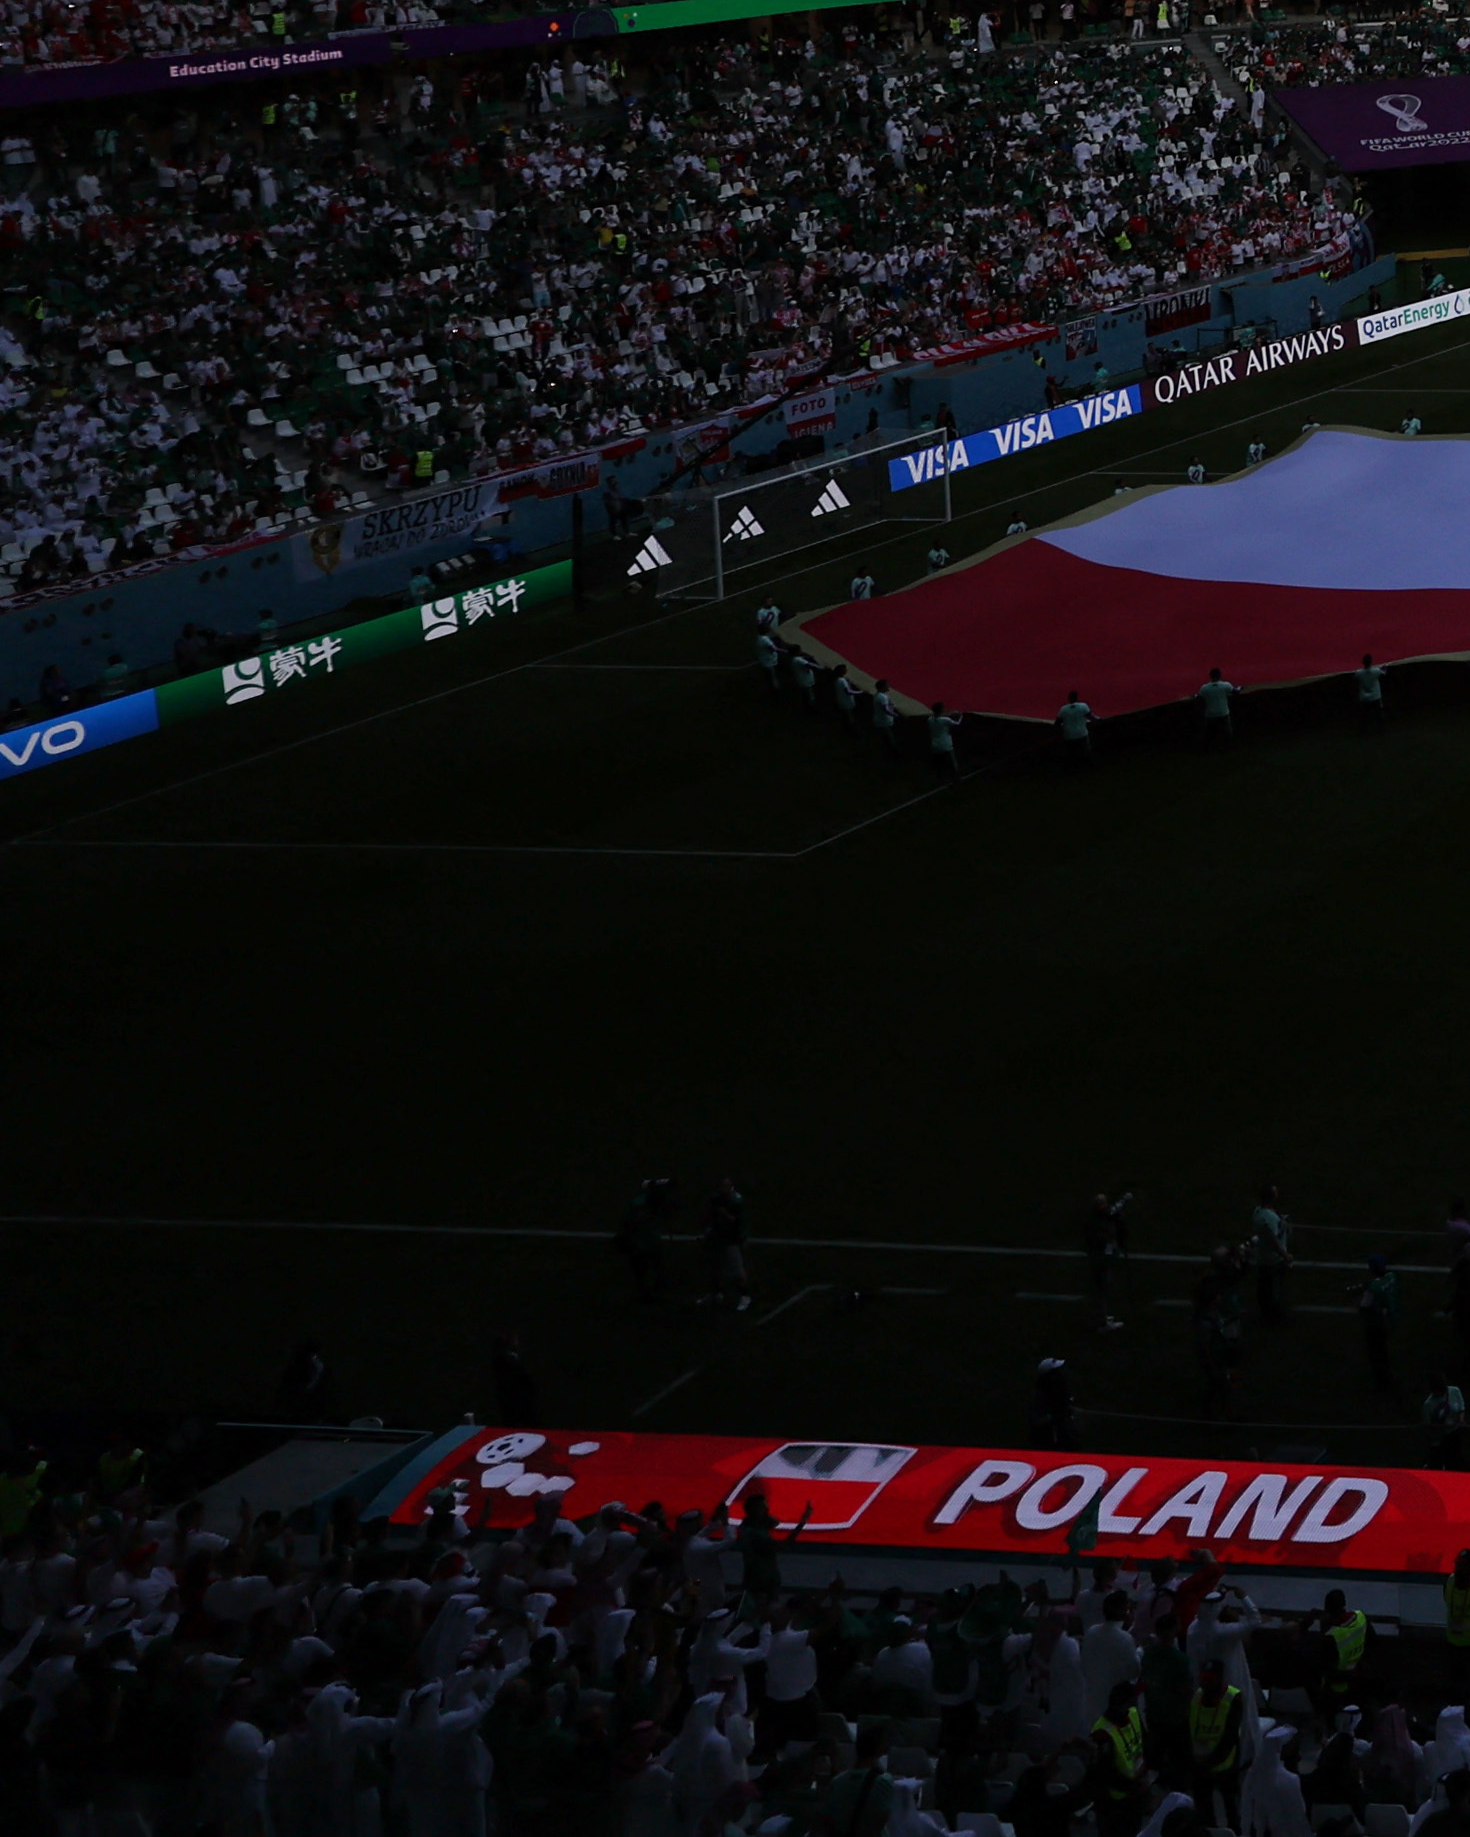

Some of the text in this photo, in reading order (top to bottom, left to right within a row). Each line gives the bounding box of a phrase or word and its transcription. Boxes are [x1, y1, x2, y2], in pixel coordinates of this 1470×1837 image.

[169, 48, 343, 78] Education City Stadium
[1359, 137, 1392, 146] FIFA
[1392, 132, 1446, 144] WORLD
[1363, 299, 1451, 339] QatarEnergy
[1154, 323, 1346, 404] QATAR AIRWAYS
[791, 397, 826, 417] FOTO
[1072, 389, 1133, 432] VISA
[989, 407, 1056, 456] VISA
[901, 439, 970, 484] VISA
[361, 484, 482, 541] SKRZYPU
[461, 579, 527, 626] 蒙牛
[268, 635, 343, 687] 蒙牛
[932, 1459, 1389, 1544] POLAND
